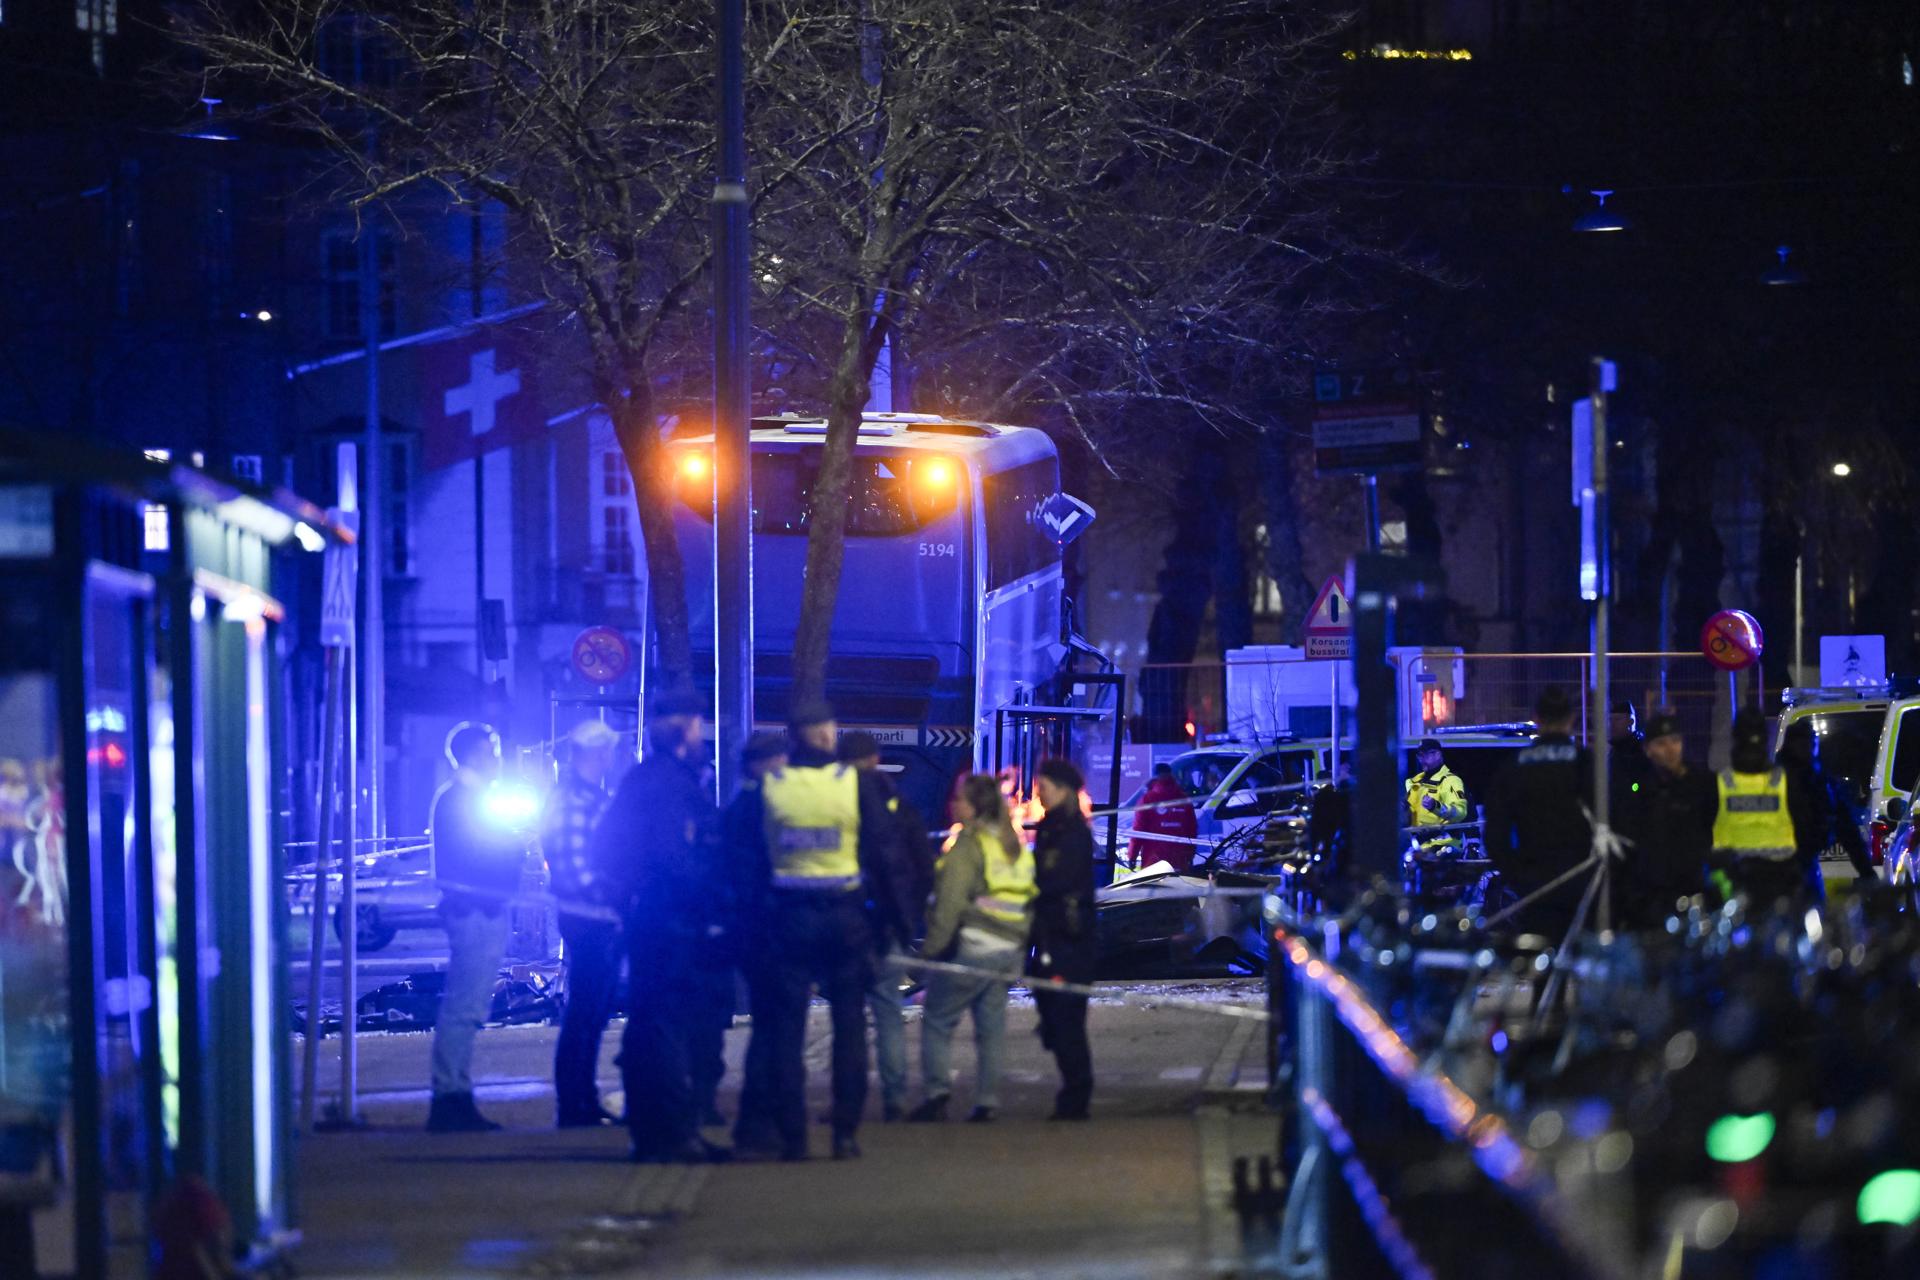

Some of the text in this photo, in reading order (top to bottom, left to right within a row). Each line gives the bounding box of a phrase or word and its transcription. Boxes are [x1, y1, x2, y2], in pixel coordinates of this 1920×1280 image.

[919, 542, 955, 558] 5194
[1311, 637, 1351, 646] Korsand
[866, 728, 905, 742] kparti
